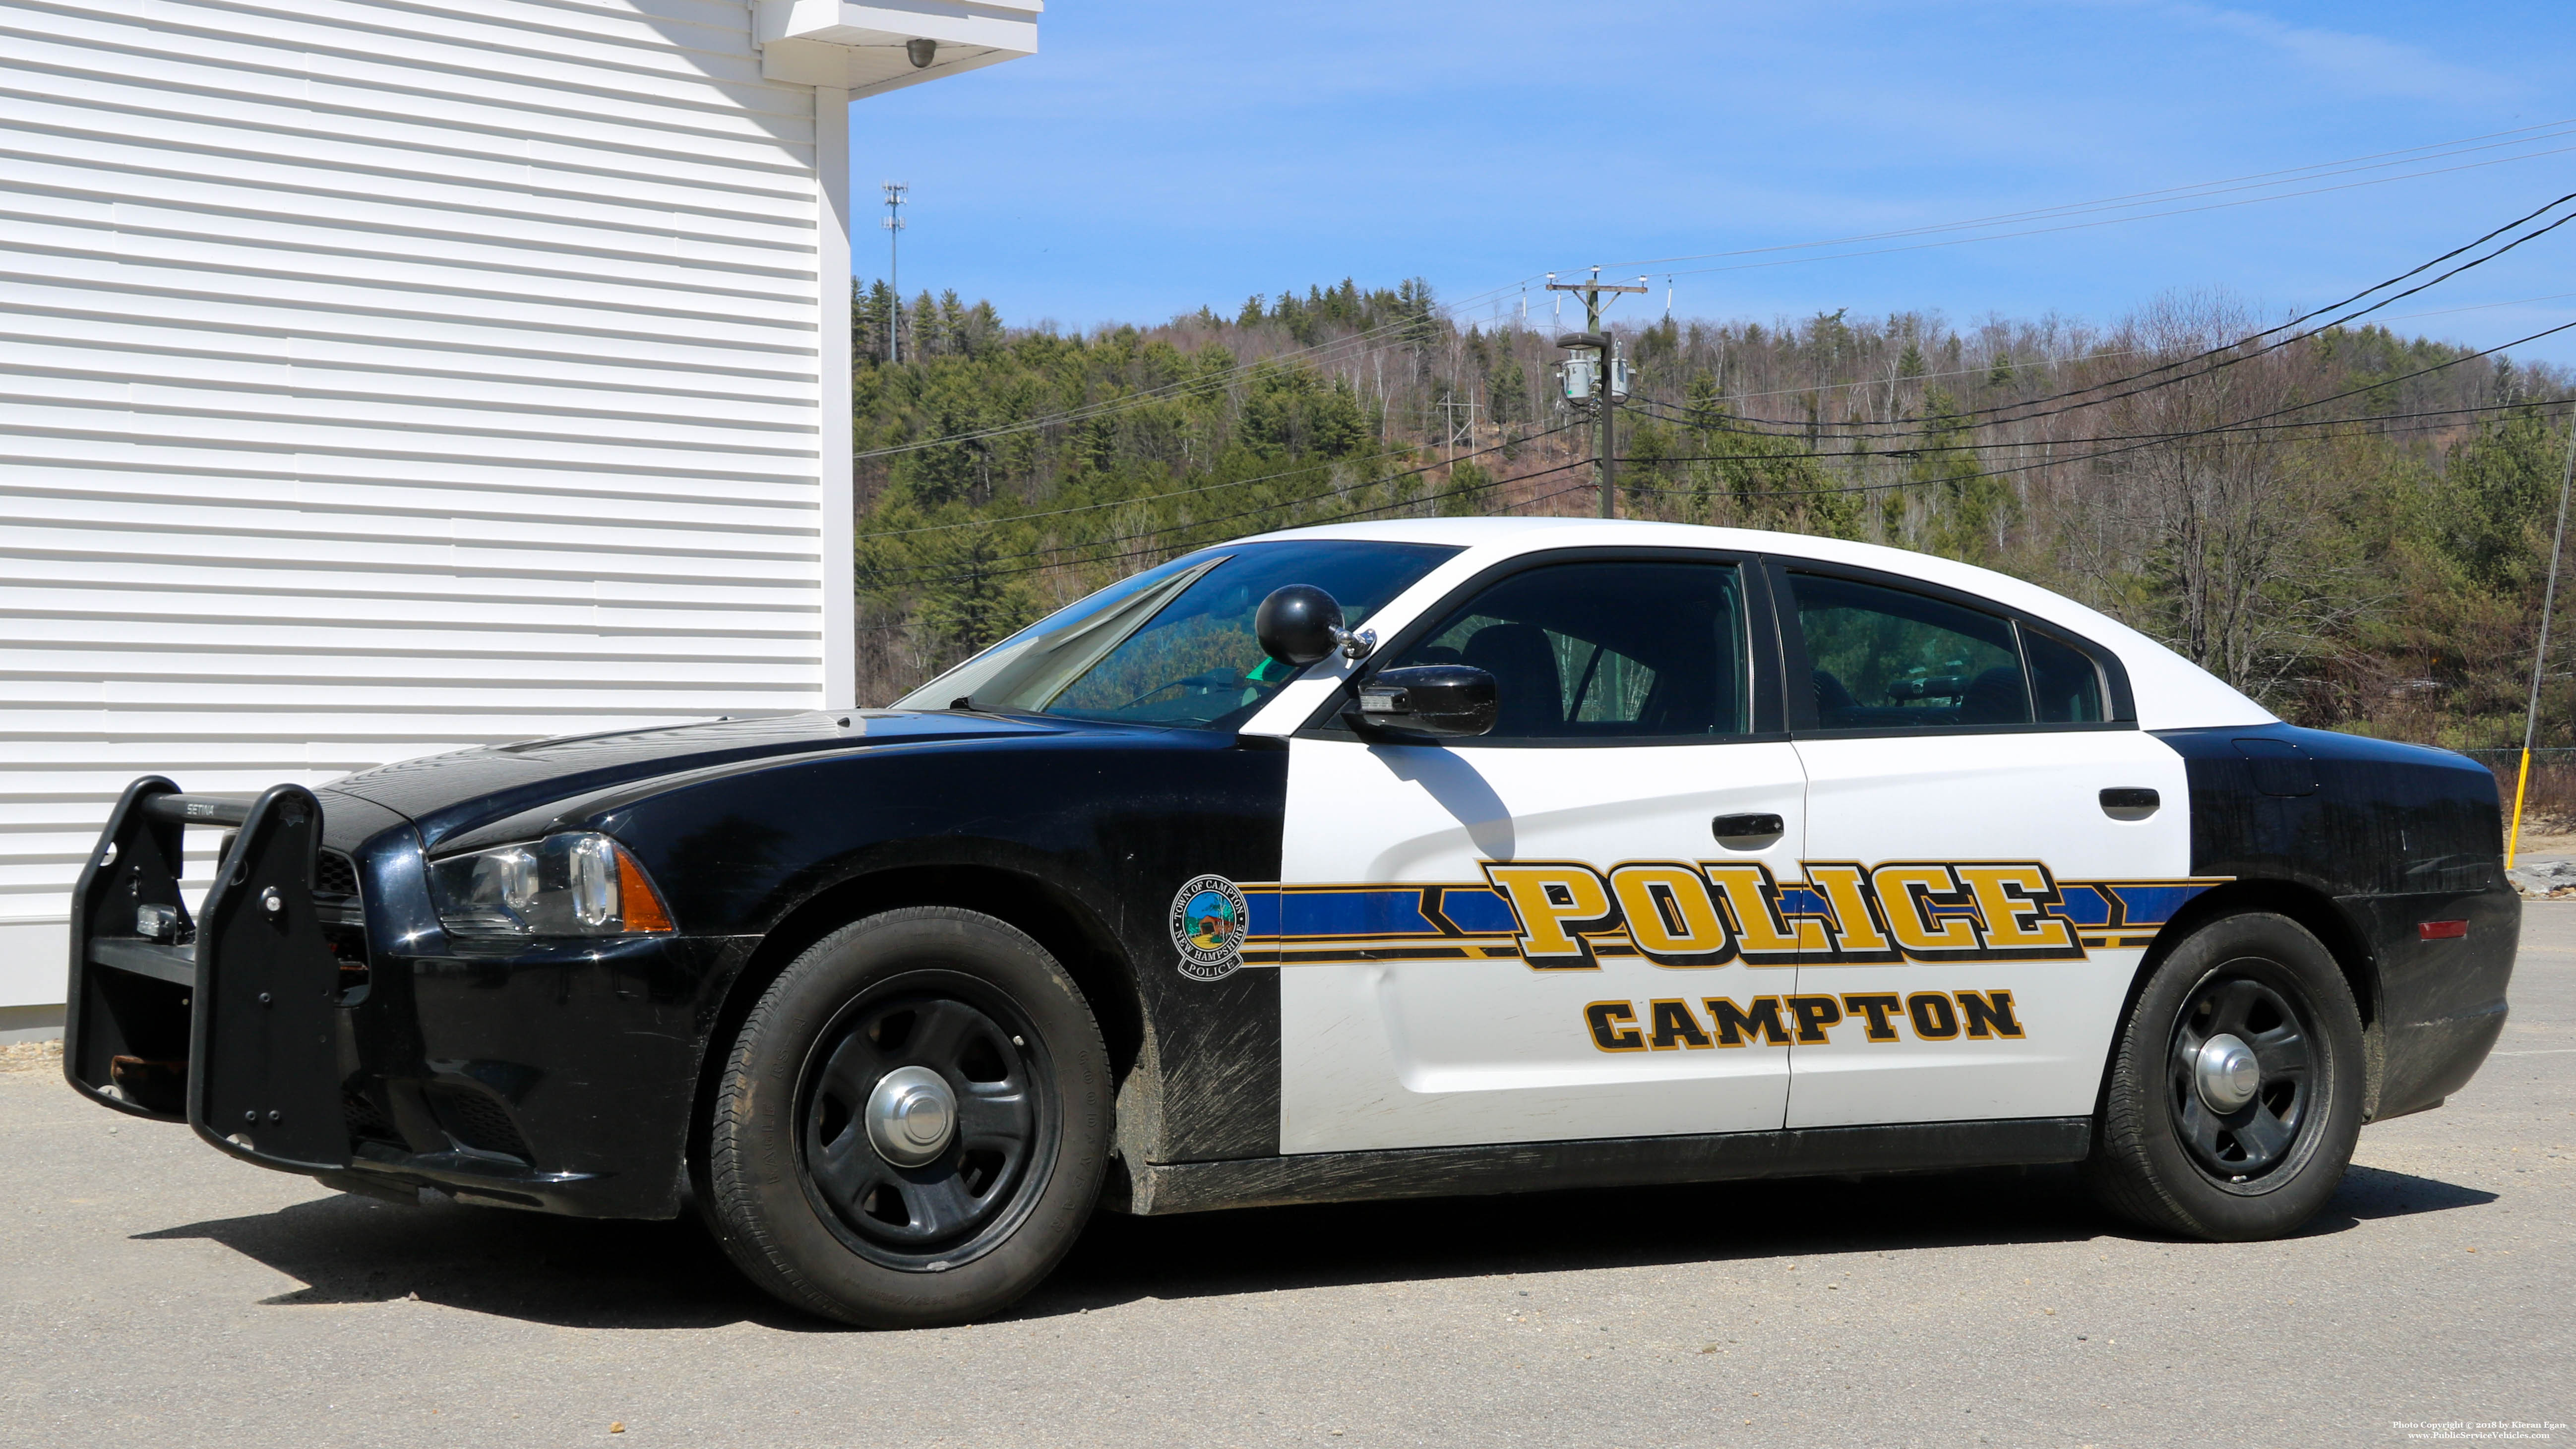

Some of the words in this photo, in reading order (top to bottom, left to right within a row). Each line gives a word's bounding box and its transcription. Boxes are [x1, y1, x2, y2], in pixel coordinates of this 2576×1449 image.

[187, 804, 214, 816] SETINA
[1174, 891, 1192, 920] TOWN
[1191, 881, 1204, 893] OF
[1206, 880, 1244, 914] CAMPTON
[1474, 859, 2089, 970] POLICE
[1175, 930, 1194, 953] NEW
[1194, 924, 1244, 961] HAMPSHIRE
[1188, 959, 1234, 976] POLICE
[770, 1017, 806, 1079] RS-A
[1584, 989, 2025, 1052] CAMPTON
[762, 1102, 780, 1184] EAGLE
[1050, 1050, 1097, 1232] GOODYEAR
